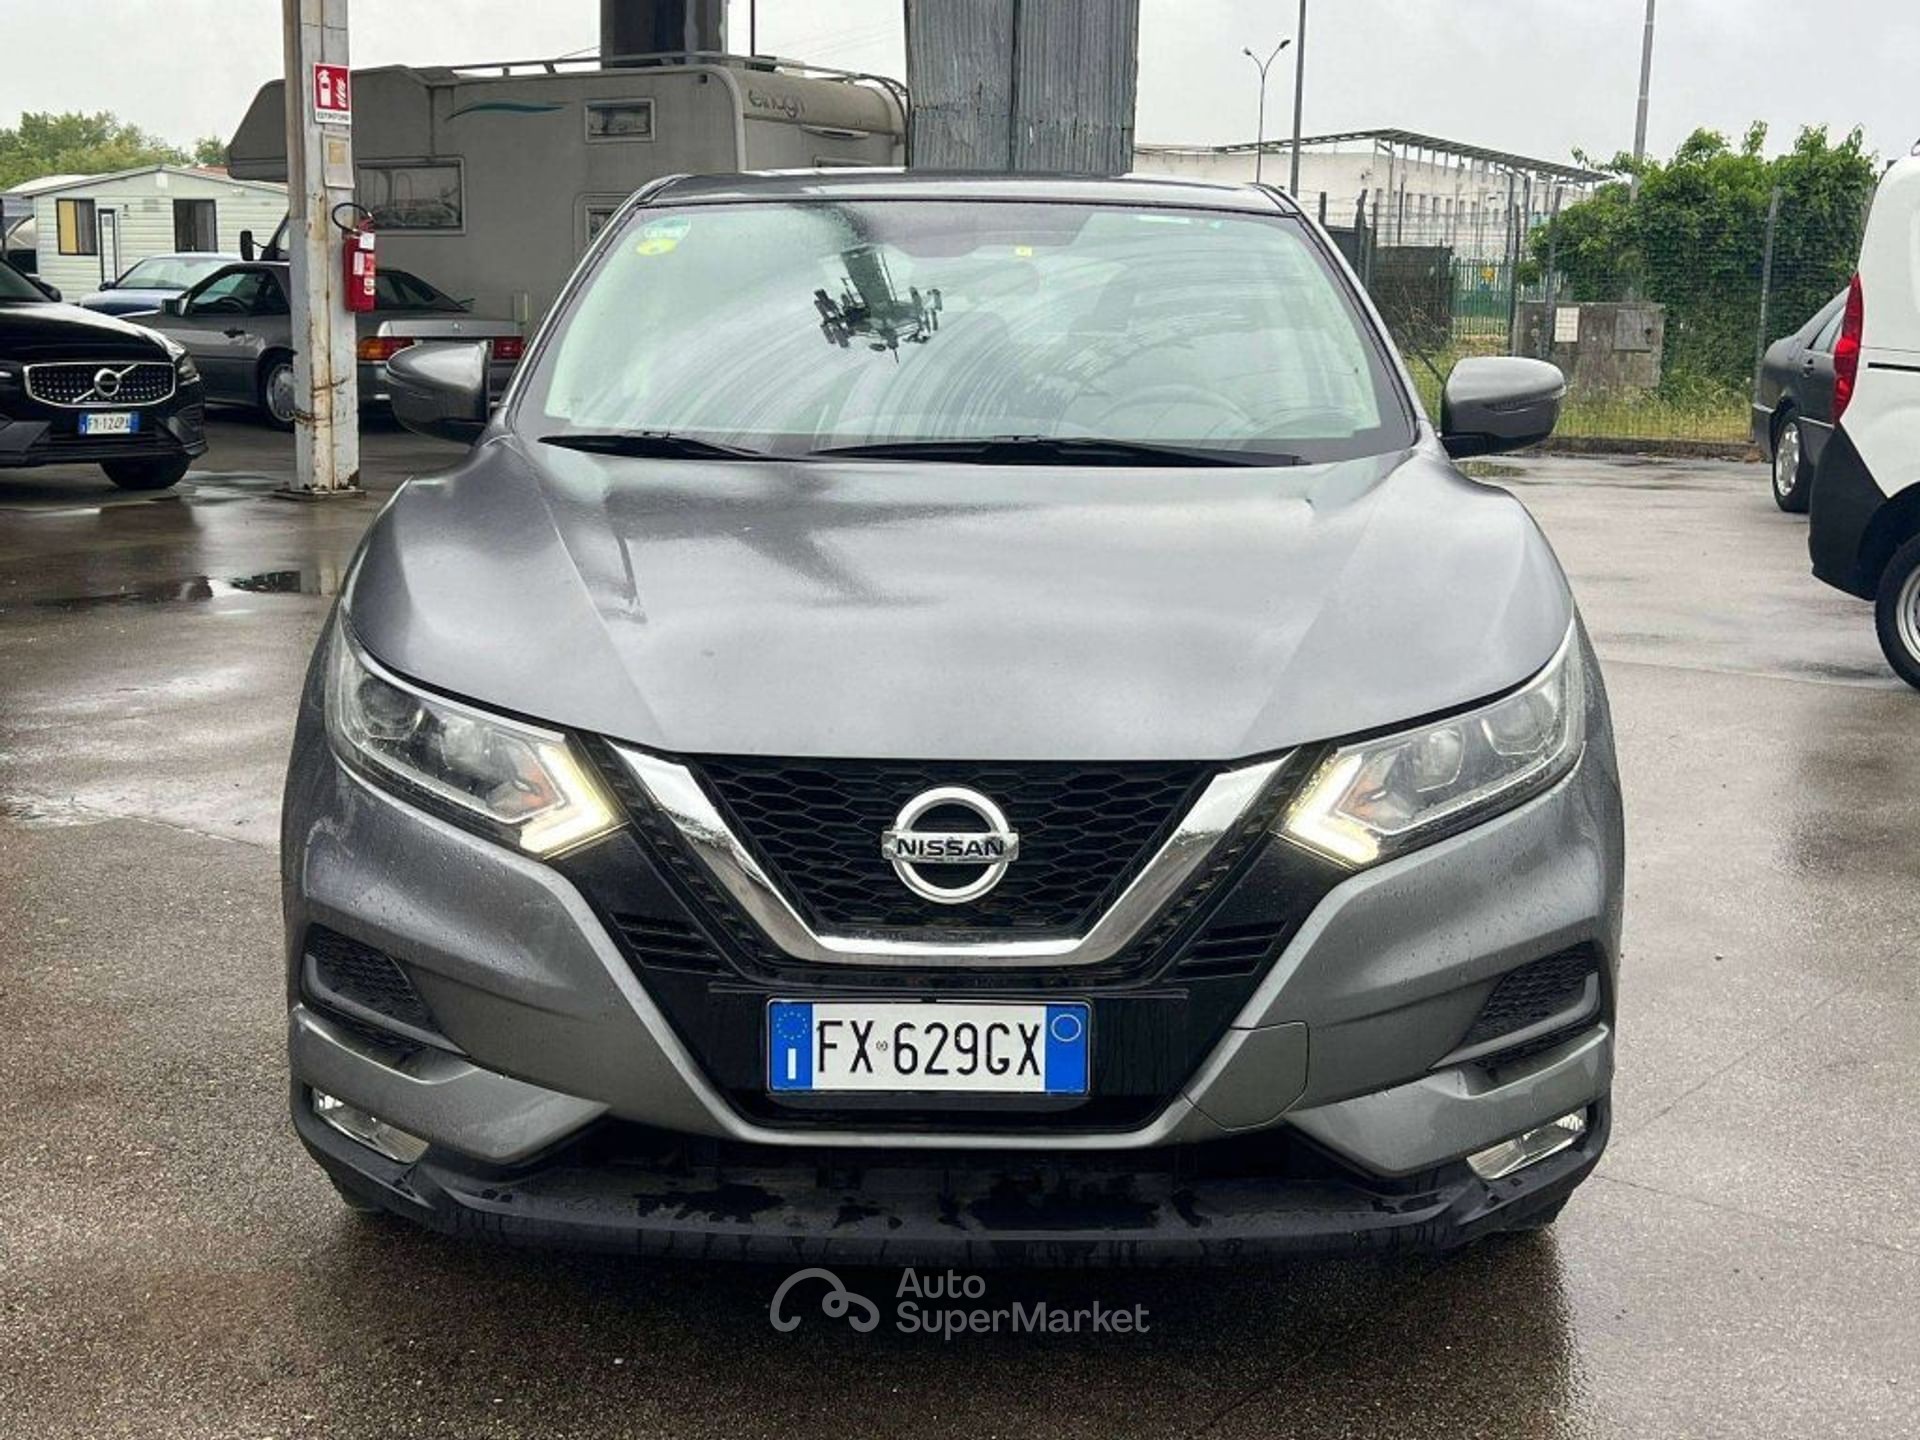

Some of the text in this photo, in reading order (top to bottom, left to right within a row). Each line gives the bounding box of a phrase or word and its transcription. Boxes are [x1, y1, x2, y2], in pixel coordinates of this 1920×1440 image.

[896, 838, 1004, 856] NISSAN
[817, 1020, 1041, 1076] FX 629GX
